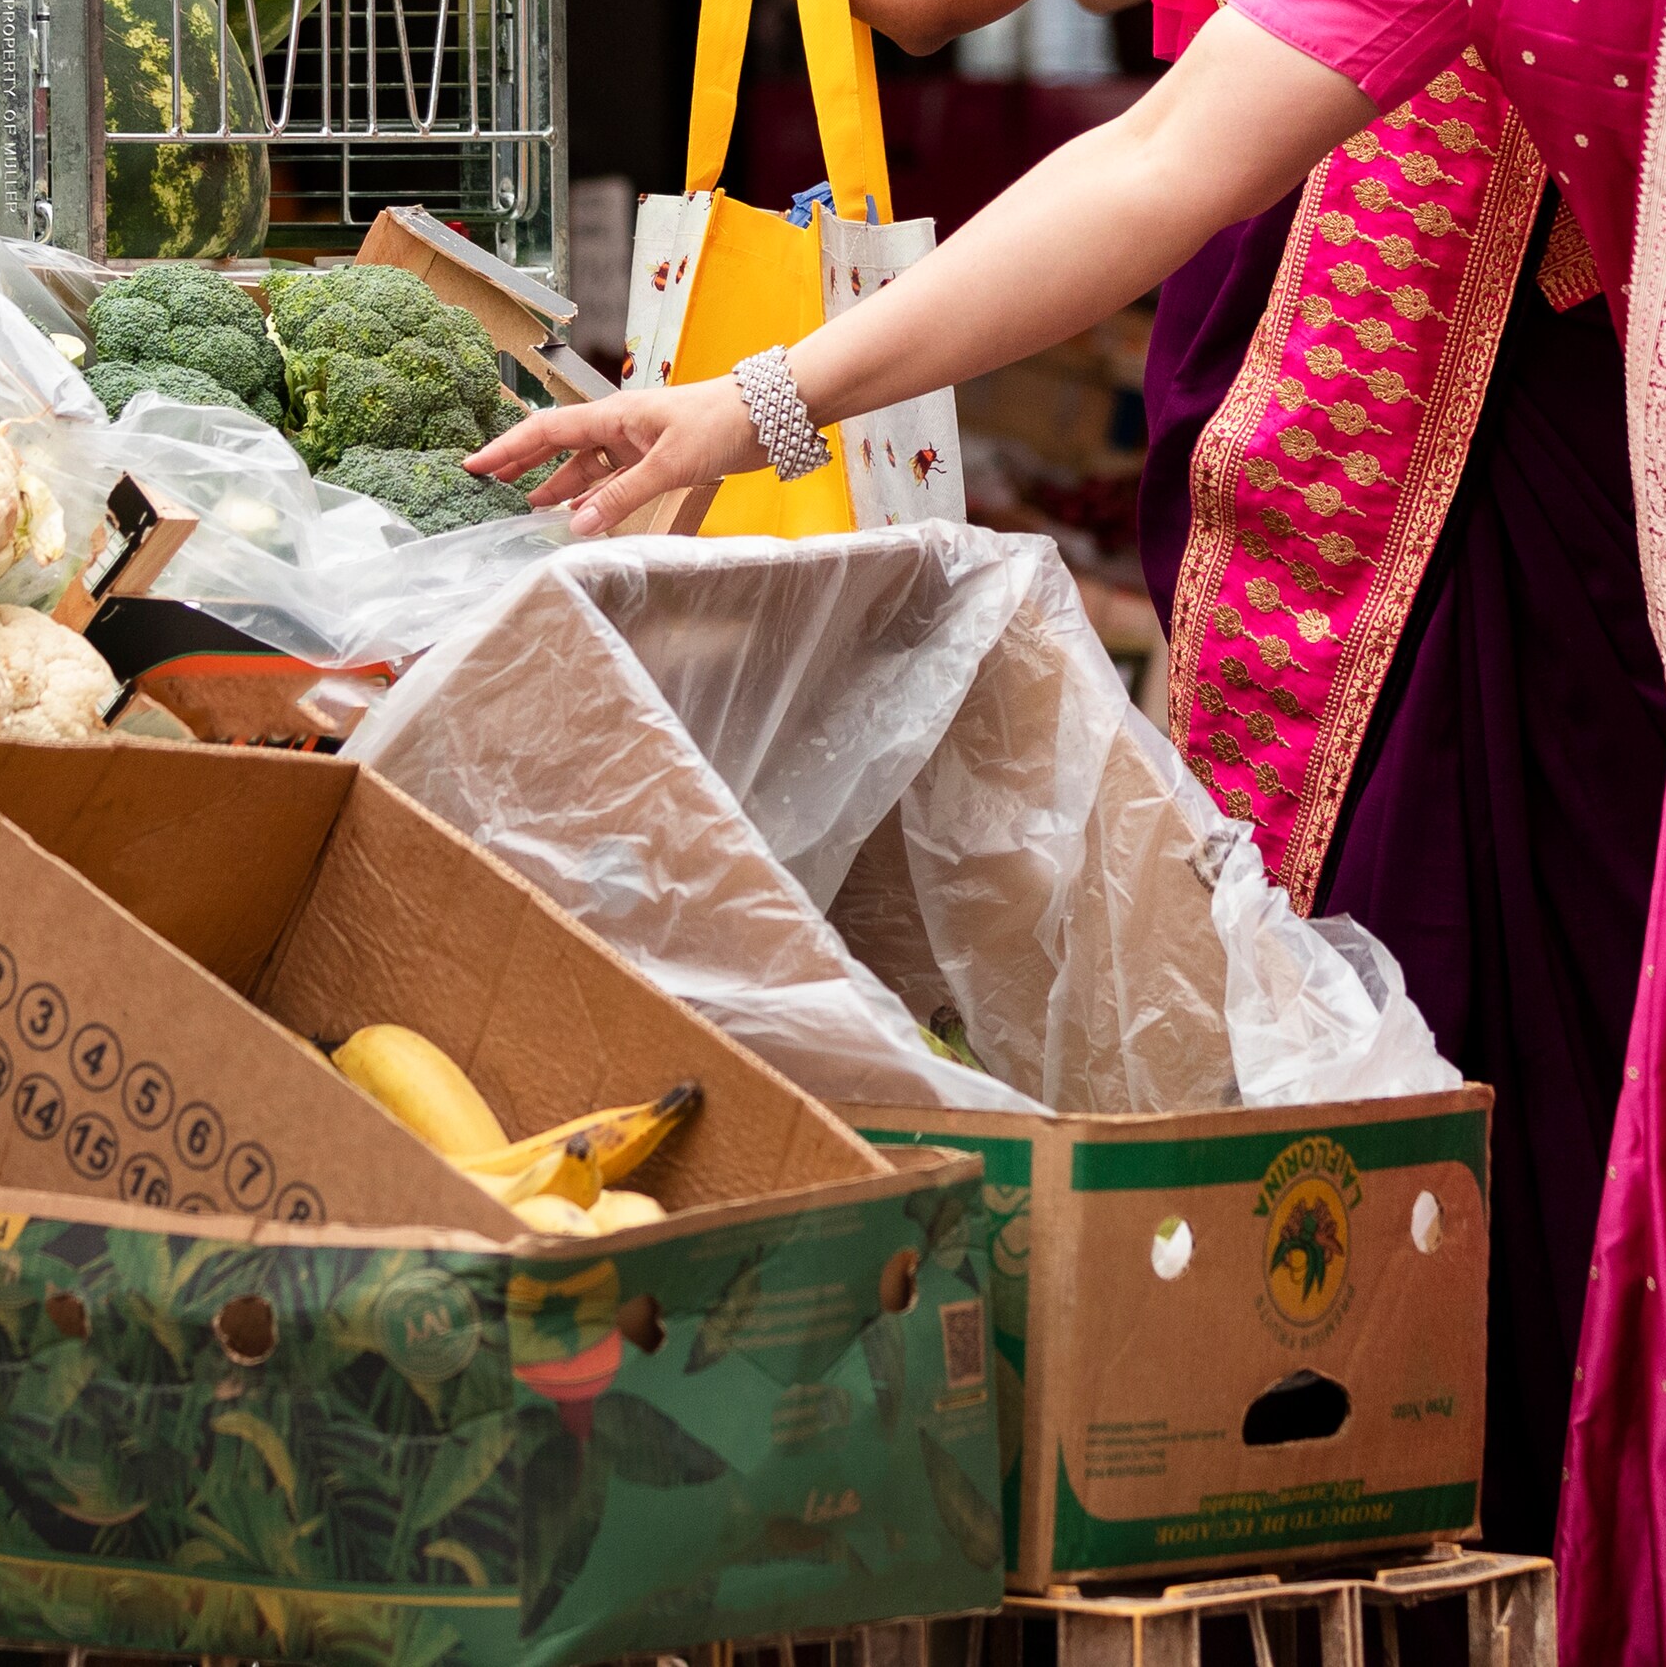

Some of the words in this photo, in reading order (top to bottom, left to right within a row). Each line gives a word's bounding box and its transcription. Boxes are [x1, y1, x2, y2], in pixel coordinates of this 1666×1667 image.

[1, 0, 18, 98] PROPERTY
[2, 109, 18, 135] OF
[21, 1084, 59, 1132] 14
[74, 1124, 115, 1170] 15
[1154, 1516, 1257, 1546] ECUADOR
[1289, 1501, 1395, 1531] PRODUCTO
